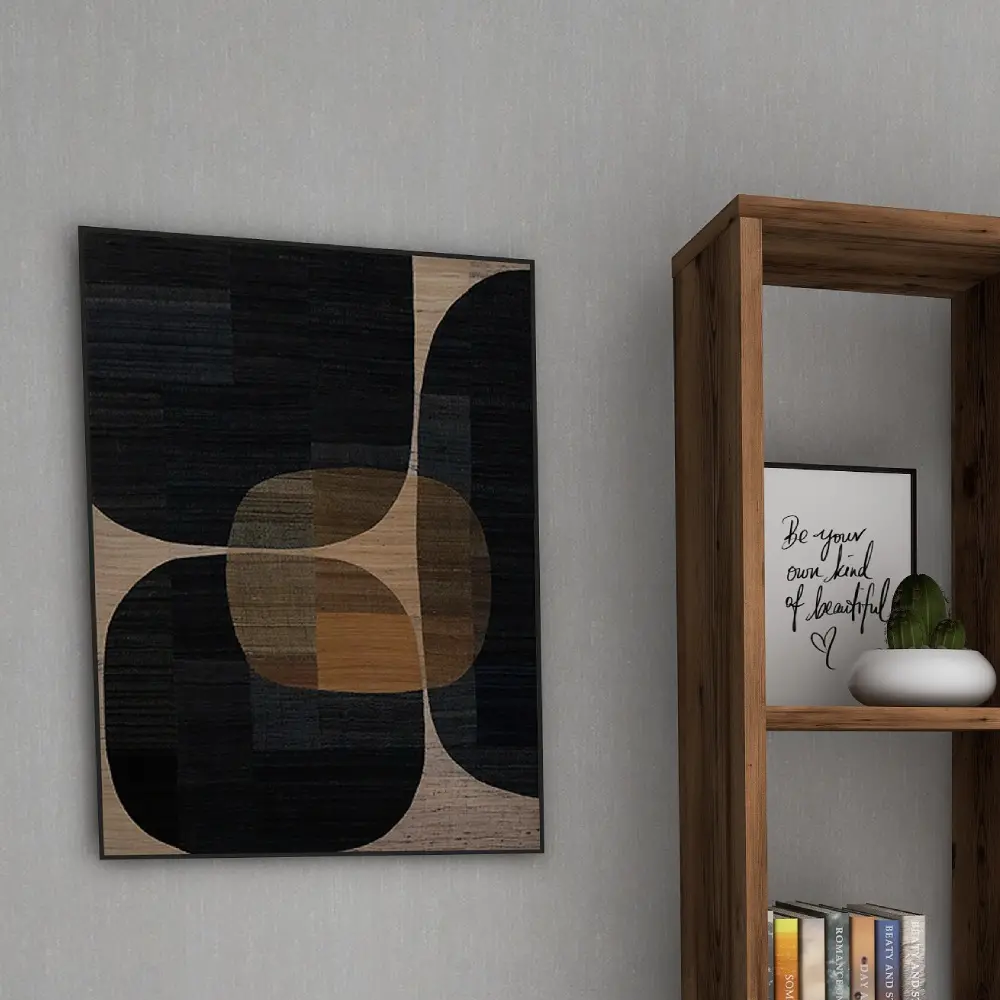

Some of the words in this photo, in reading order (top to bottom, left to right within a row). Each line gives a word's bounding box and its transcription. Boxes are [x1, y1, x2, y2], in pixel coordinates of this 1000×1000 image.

[781, 514, 808, 550] Be
[813, 528, 867, 562] your
[787, 565, 823, 582] own
[823, 540, 873, 583] kind
[785, 584, 805, 633] of
[805, 578, 891, 634] beautiful
[835, 927, 844, 985] ROMANCE
[885, 925, 893, 961] BEATY
[910, 920, 920, 958] BEATY
[860, 964, 869, 989] DAY
[885, 964, 893, 989] AND
[910, 963, 920, 988] AND
